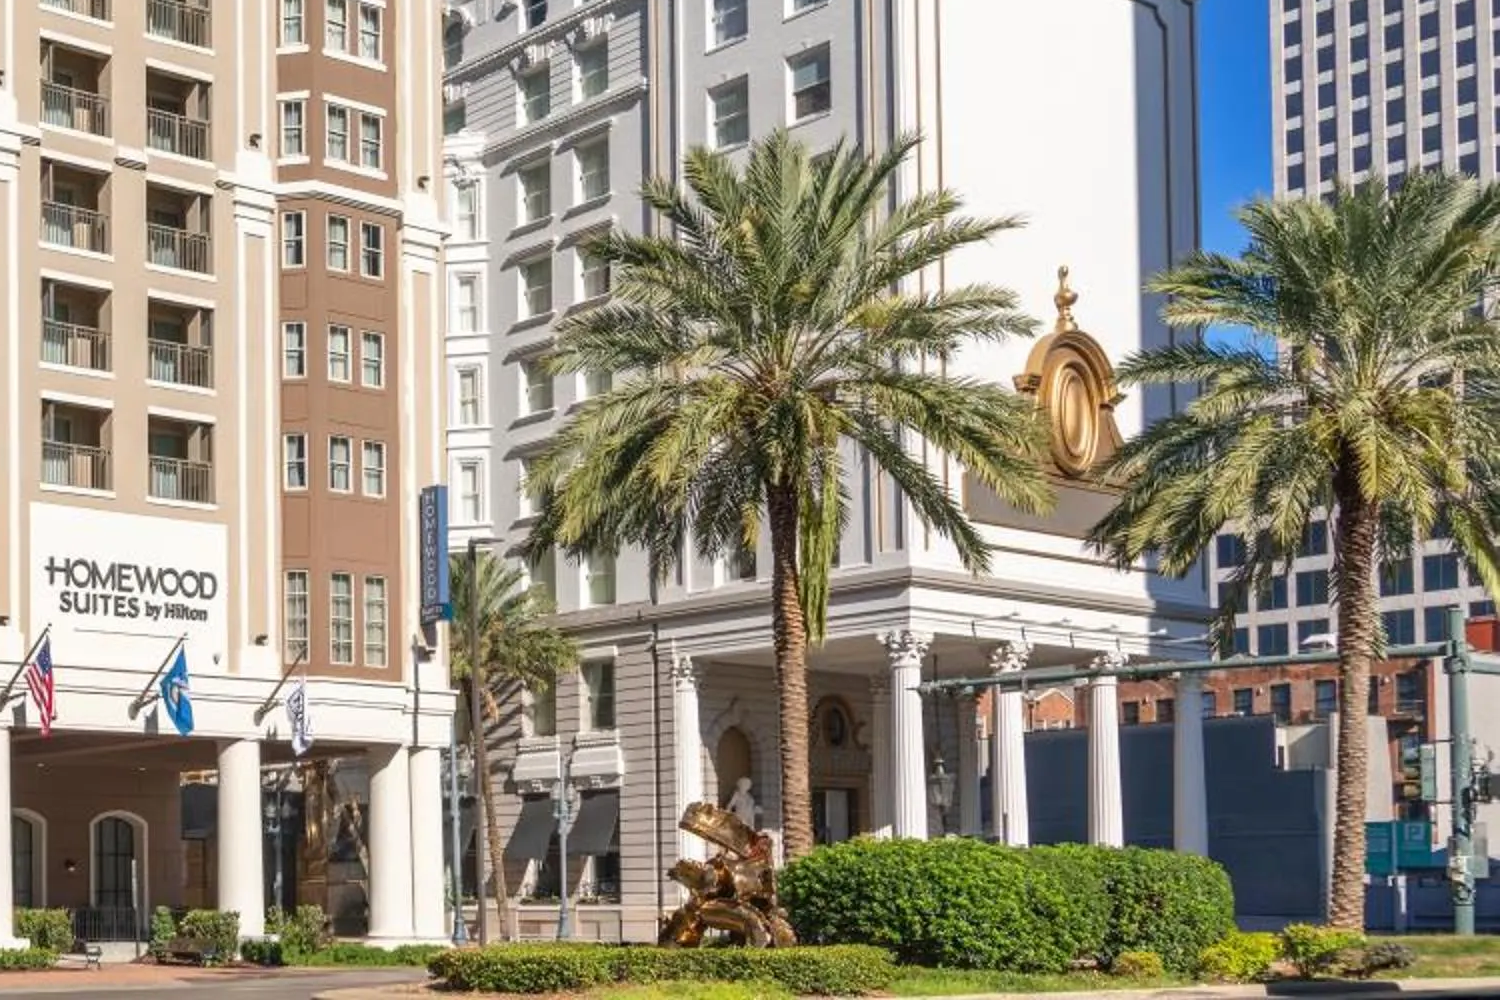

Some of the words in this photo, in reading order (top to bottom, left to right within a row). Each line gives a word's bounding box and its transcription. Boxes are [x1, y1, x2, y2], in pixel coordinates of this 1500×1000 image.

[44, 556, 218, 600] HOMEWOOD
[59, 590, 141, 618] SUITES
[145, 601, 162, 621] by
[164, 602, 208, 621] Hilton
